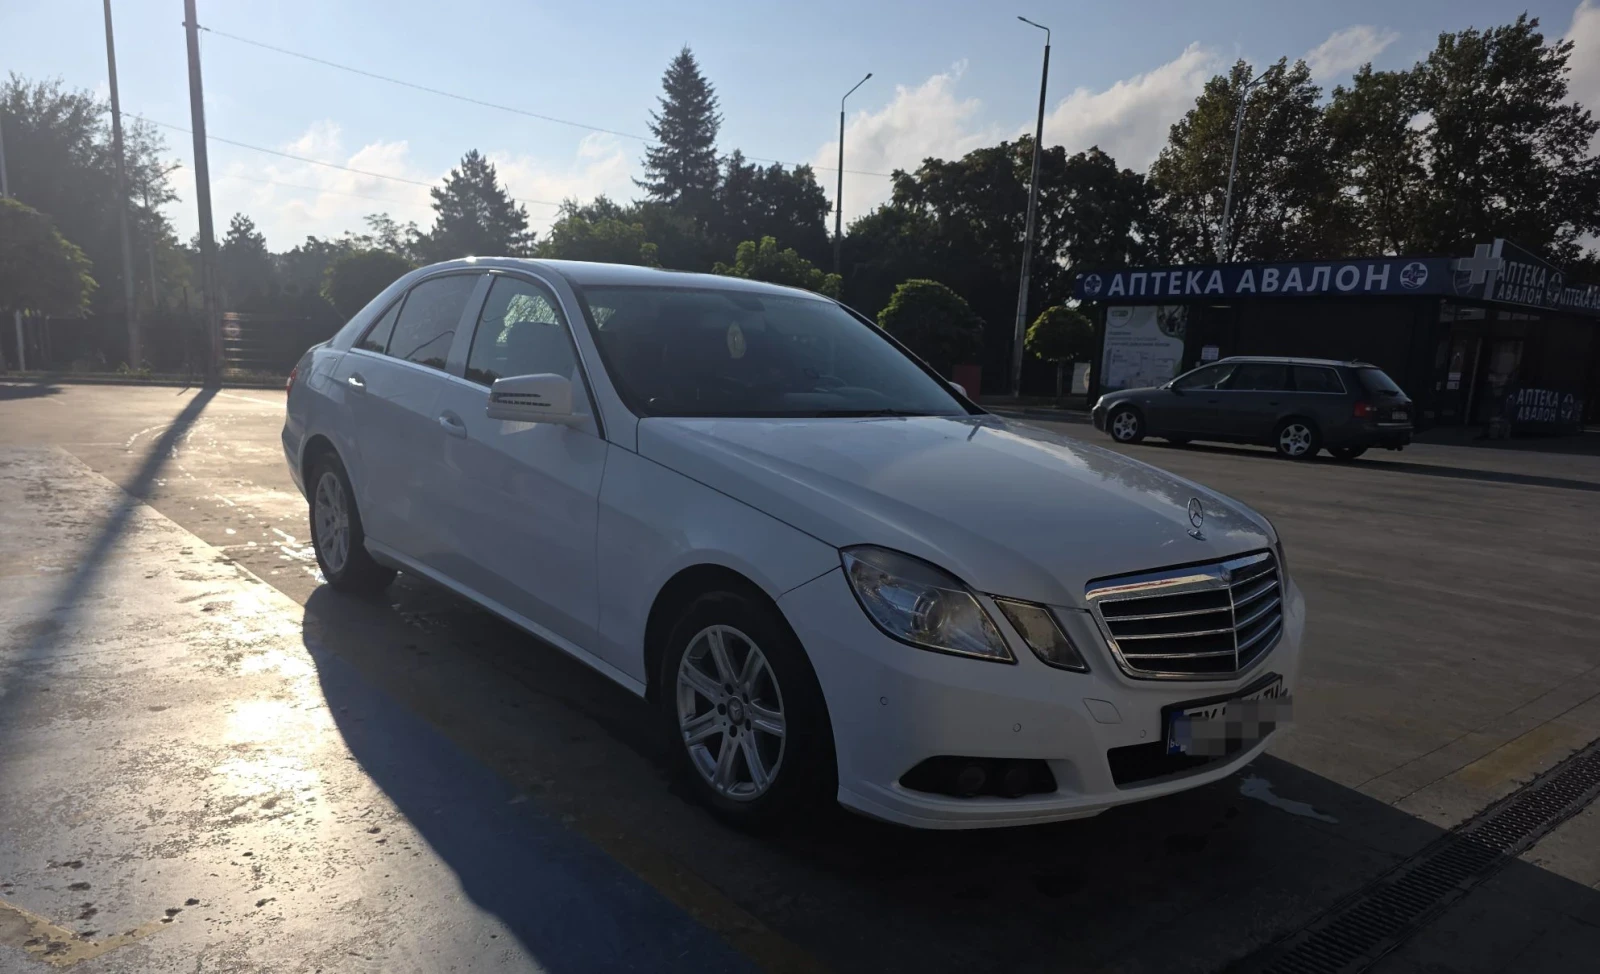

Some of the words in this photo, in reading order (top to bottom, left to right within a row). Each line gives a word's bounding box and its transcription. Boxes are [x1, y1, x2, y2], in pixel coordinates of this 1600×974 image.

[1107, 270, 1225, 296] АПТЕКА
[1235, 264, 1391, 294] АВАЛОН
[1497, 260, 1547, 288] АПТЕКА
[1497, 285, 1543, 305] АВАЛОН
[1516, 388, 1559, 408] АПТЕКА
[1516, 406, 1557, 423] АВАЛОН
